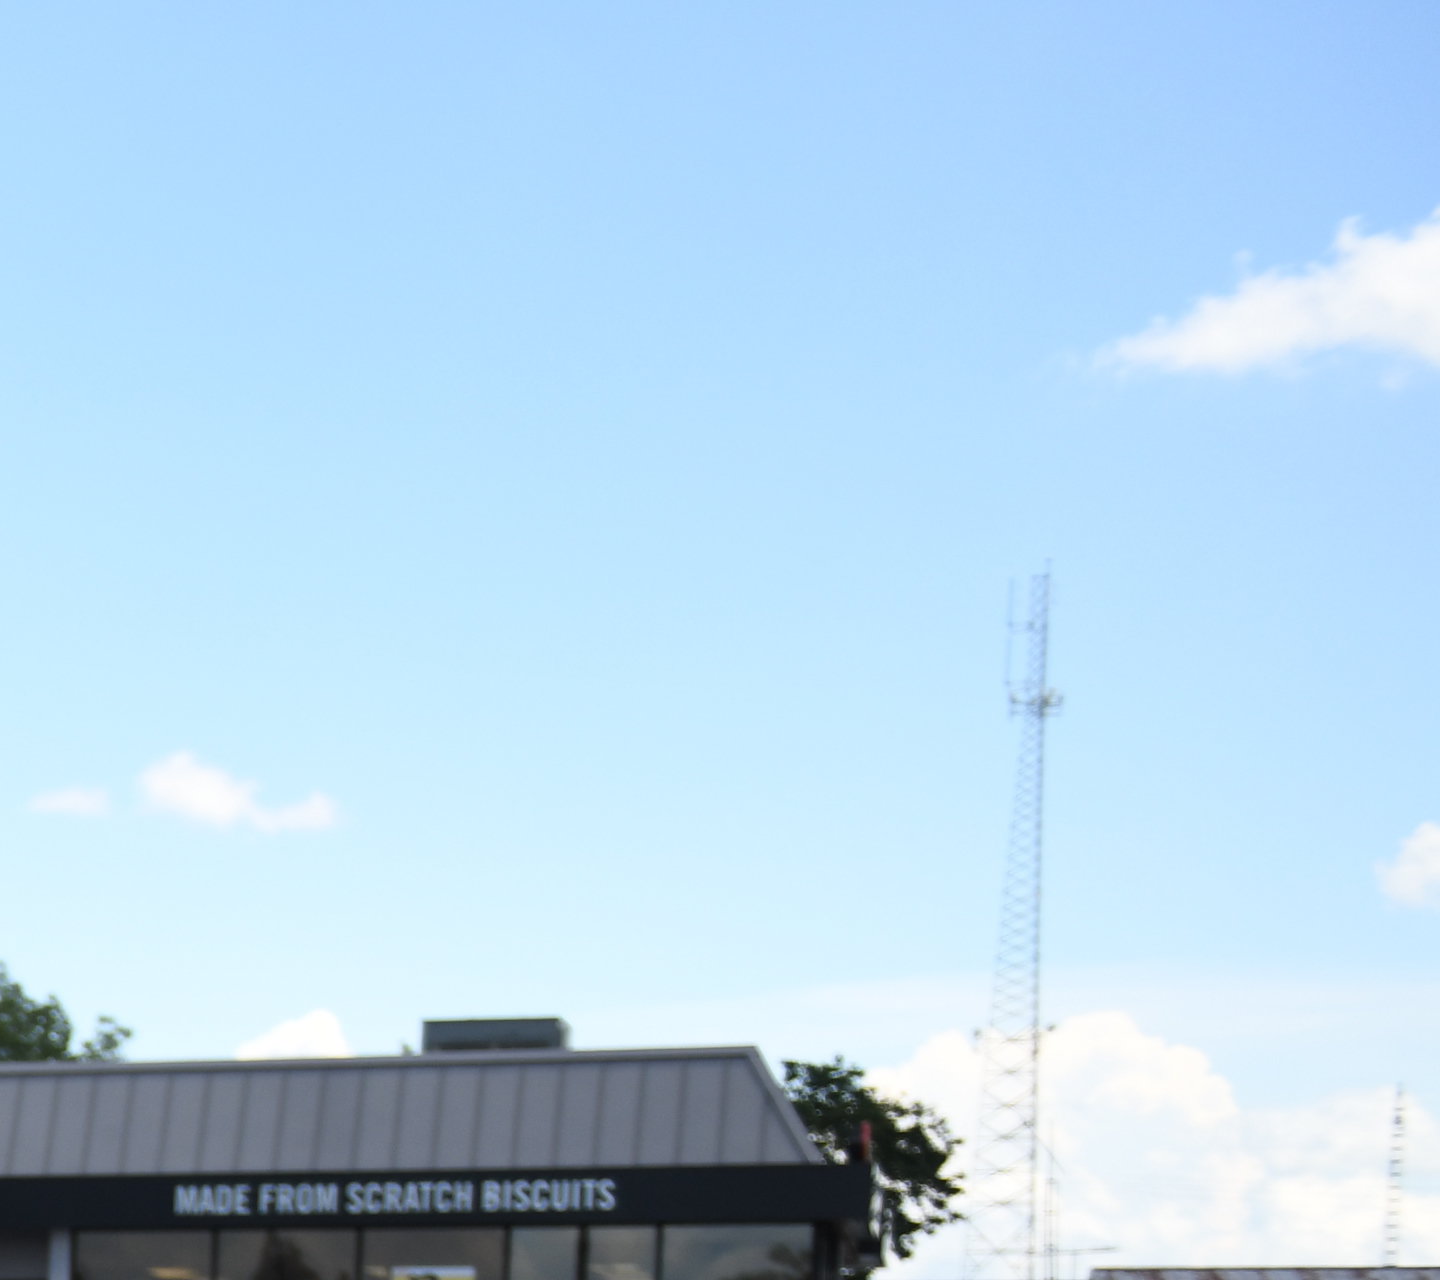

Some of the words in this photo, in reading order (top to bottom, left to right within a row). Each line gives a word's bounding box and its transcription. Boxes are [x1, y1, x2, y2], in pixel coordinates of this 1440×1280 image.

[174, 1184, 251, 1215] MADE
[258, 1183, 338, 1214] FROM
[345, 1181, 473, 1214] SCRATCH
[481, 1179, 616, 1212] BISCUITS
